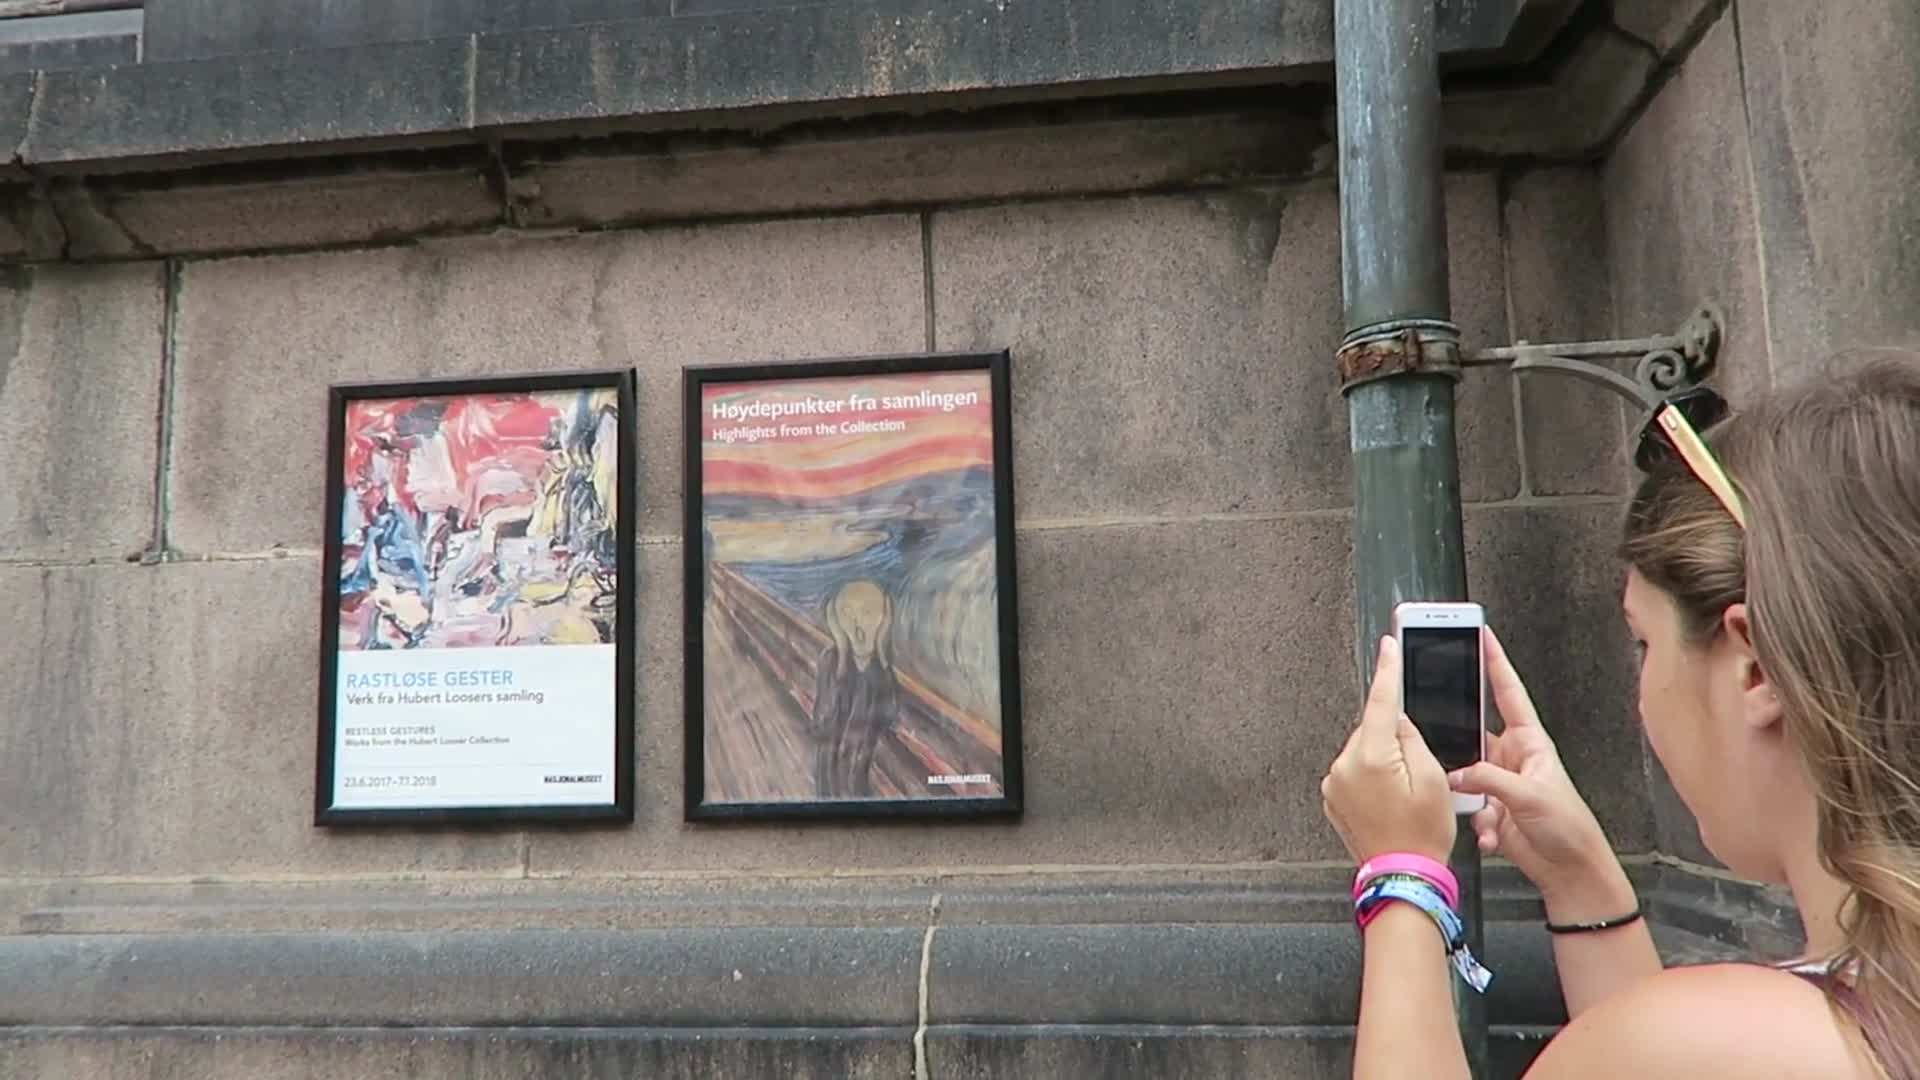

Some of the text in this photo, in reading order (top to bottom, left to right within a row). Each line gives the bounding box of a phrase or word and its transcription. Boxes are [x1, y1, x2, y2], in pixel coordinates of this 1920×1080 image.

[712, 390, 977, 421] Høydepunkter fra samlingen
[712, 419, 905, 443] Highlights from the Collection
[346, 670, 513, 689] RASTLØSE GESTER
[346, 689, 544, 705] Verk fra Hubert Loosers samling
[345, 725, 436, 737] RESTLESS GESTURES
[372, 738, 391, 746] from
[393, 737, 407, 746] the
[409, 736, 438, 746] Hubert
[468, 735, 511, 745] Collection
